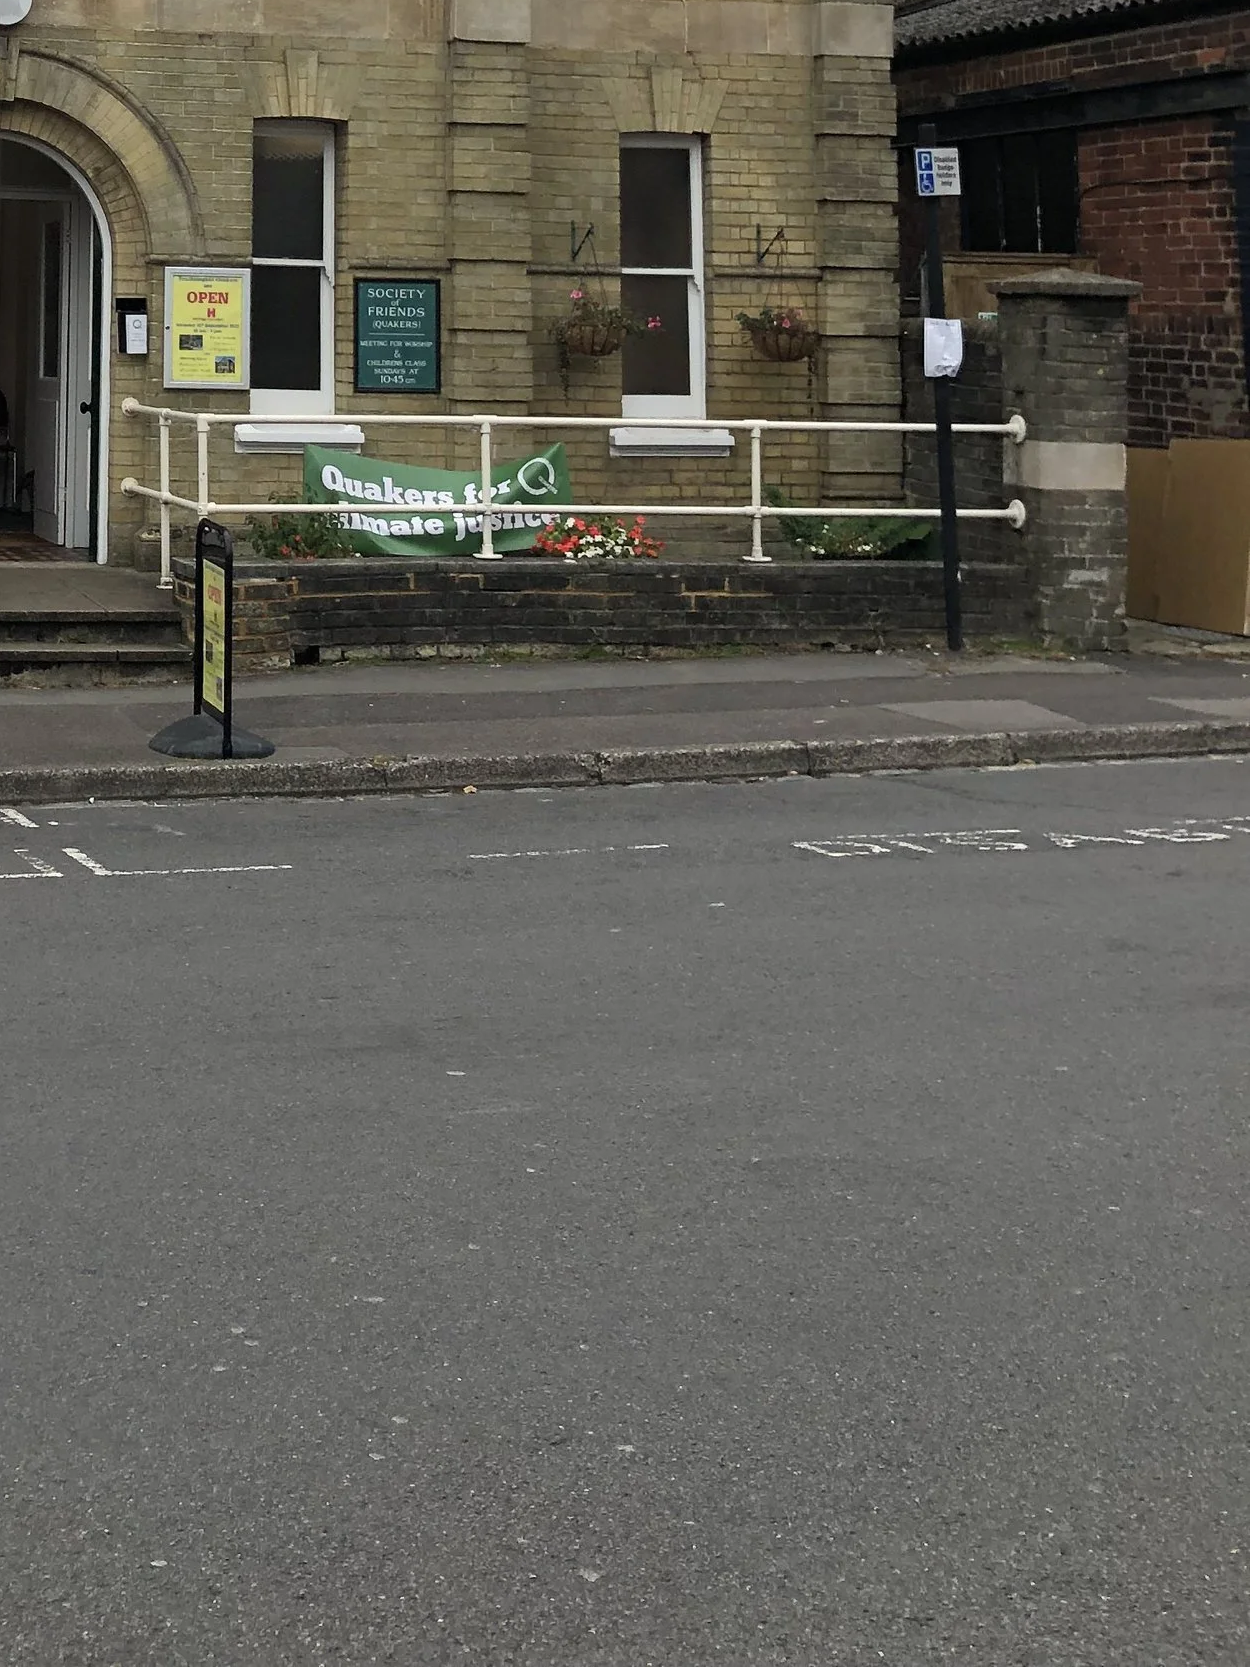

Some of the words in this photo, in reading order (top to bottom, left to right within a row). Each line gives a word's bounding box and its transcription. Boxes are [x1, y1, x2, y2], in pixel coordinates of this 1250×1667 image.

[921, 153, 931, 169] P
[187, 291, 229, 304] OPEN
[367, 288, 426, 299] SOCIETY
[391, 299, 401, 307] of
[368, 306, 425, 317] FRIENDS
[372, 320, 421, 329] (QUAKERS)
[393, 349, 401, 358] &
[321, 465, 454, 507] Quakers
